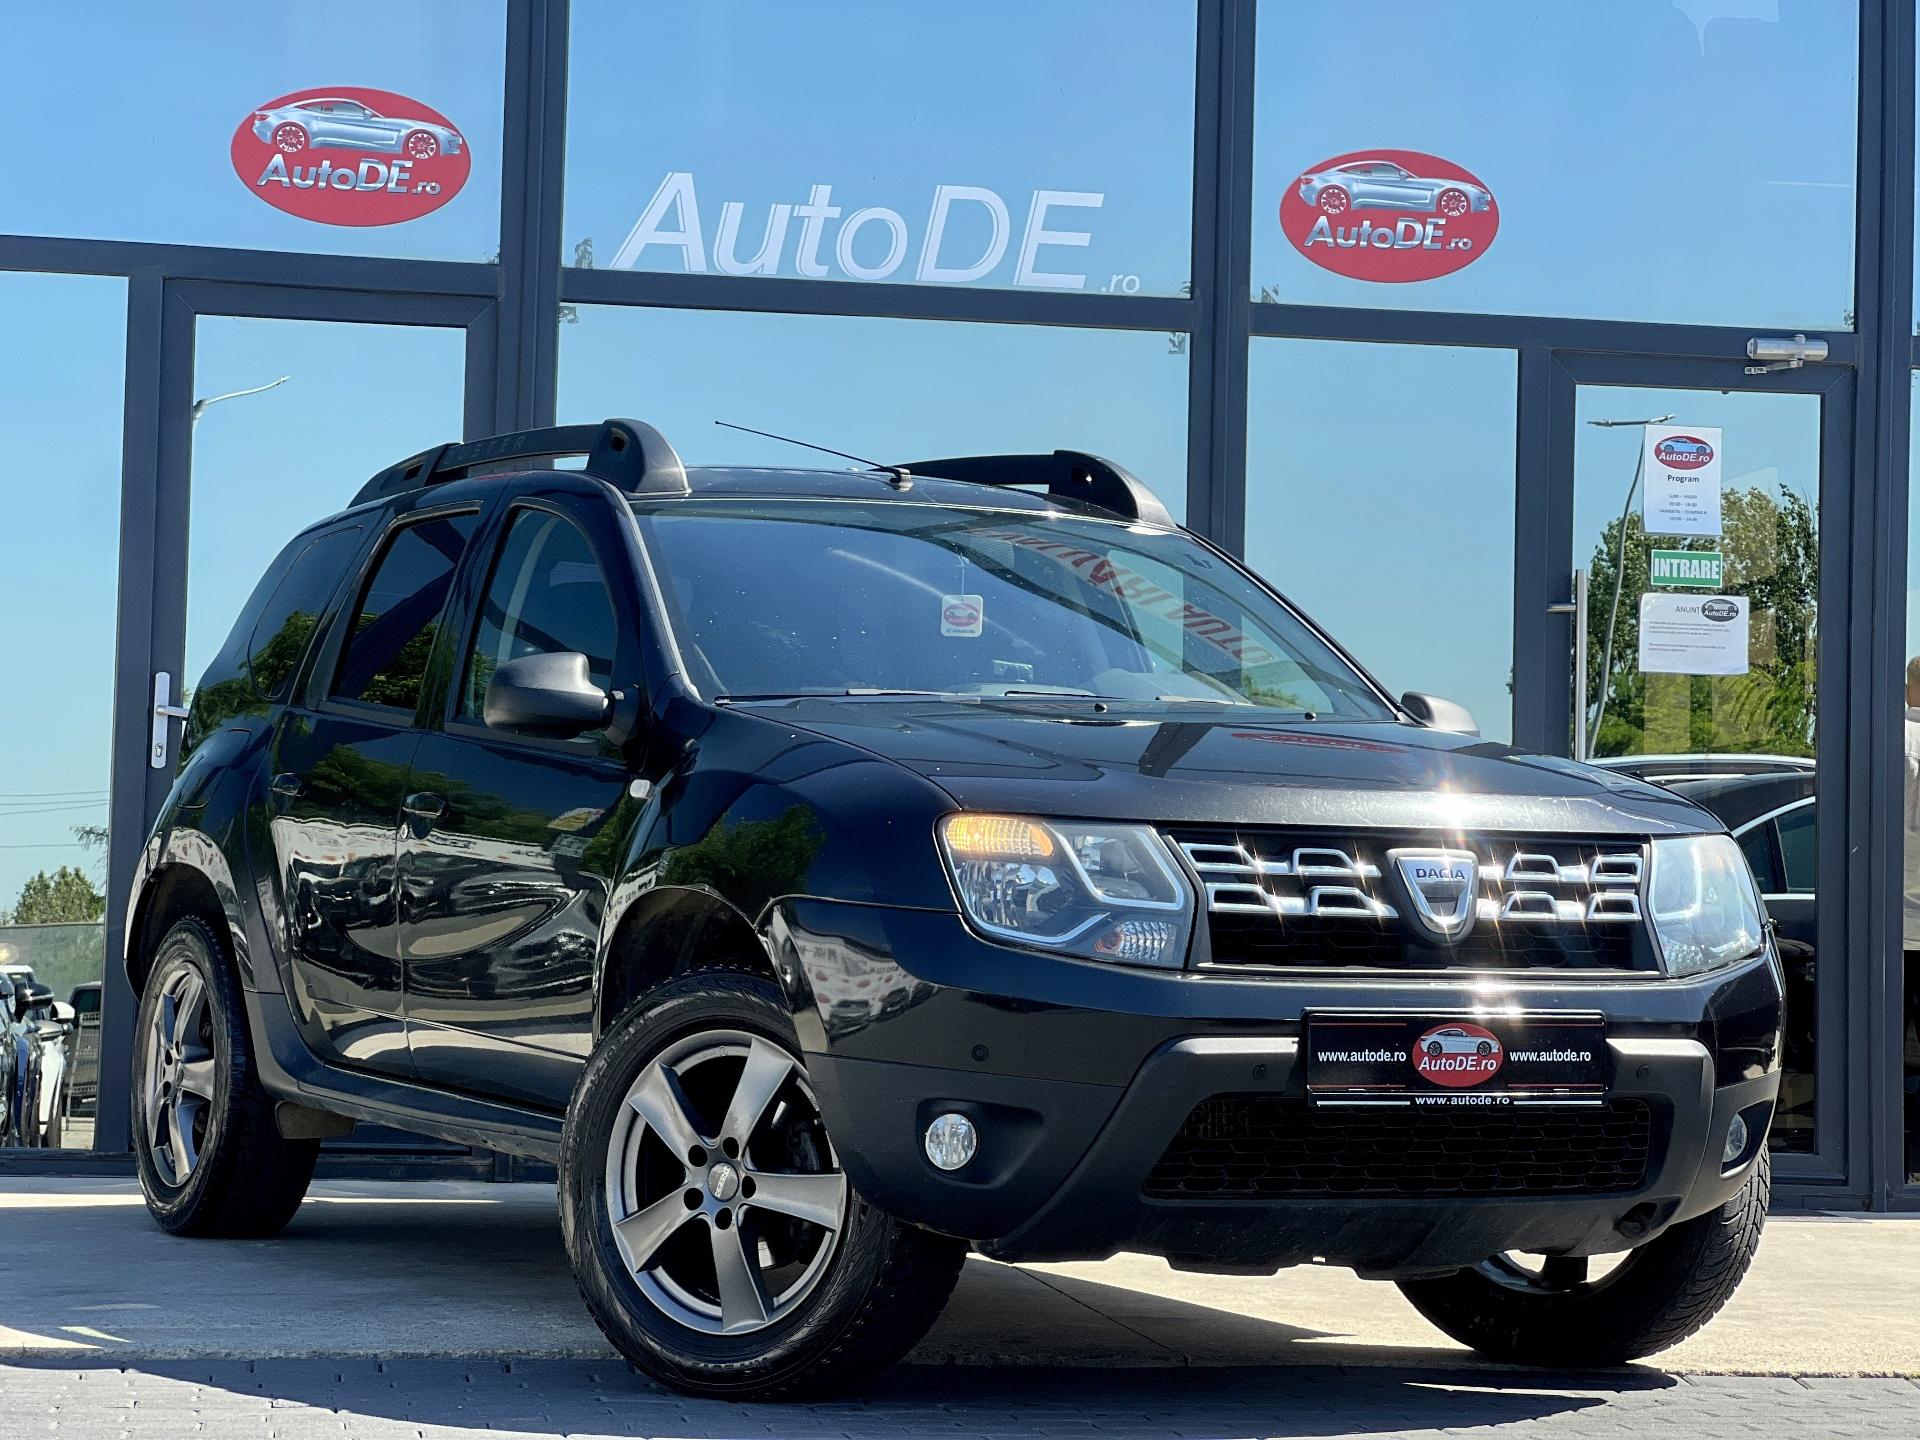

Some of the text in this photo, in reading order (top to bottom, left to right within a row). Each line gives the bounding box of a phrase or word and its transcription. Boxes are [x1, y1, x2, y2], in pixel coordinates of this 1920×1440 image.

[1658, 452, 1710, 463] AutoDE.ro
[1667, 474, 1700, 484] Program
[1654, 557, 1720, 579] INTRARE
[1703, 609, 1737, 618] AutoDE.ro
[1415, 868, 1466, 880] DACIA
[1318, 1048, 1407, 1062] www.autode.ro
[1509, 1049, 1592, 1062] www.autode.ro
[1418, 1056, 1497, 1072] AutoDE.ro
[1414, 1095, 1510, 1106] www.autode.ro
